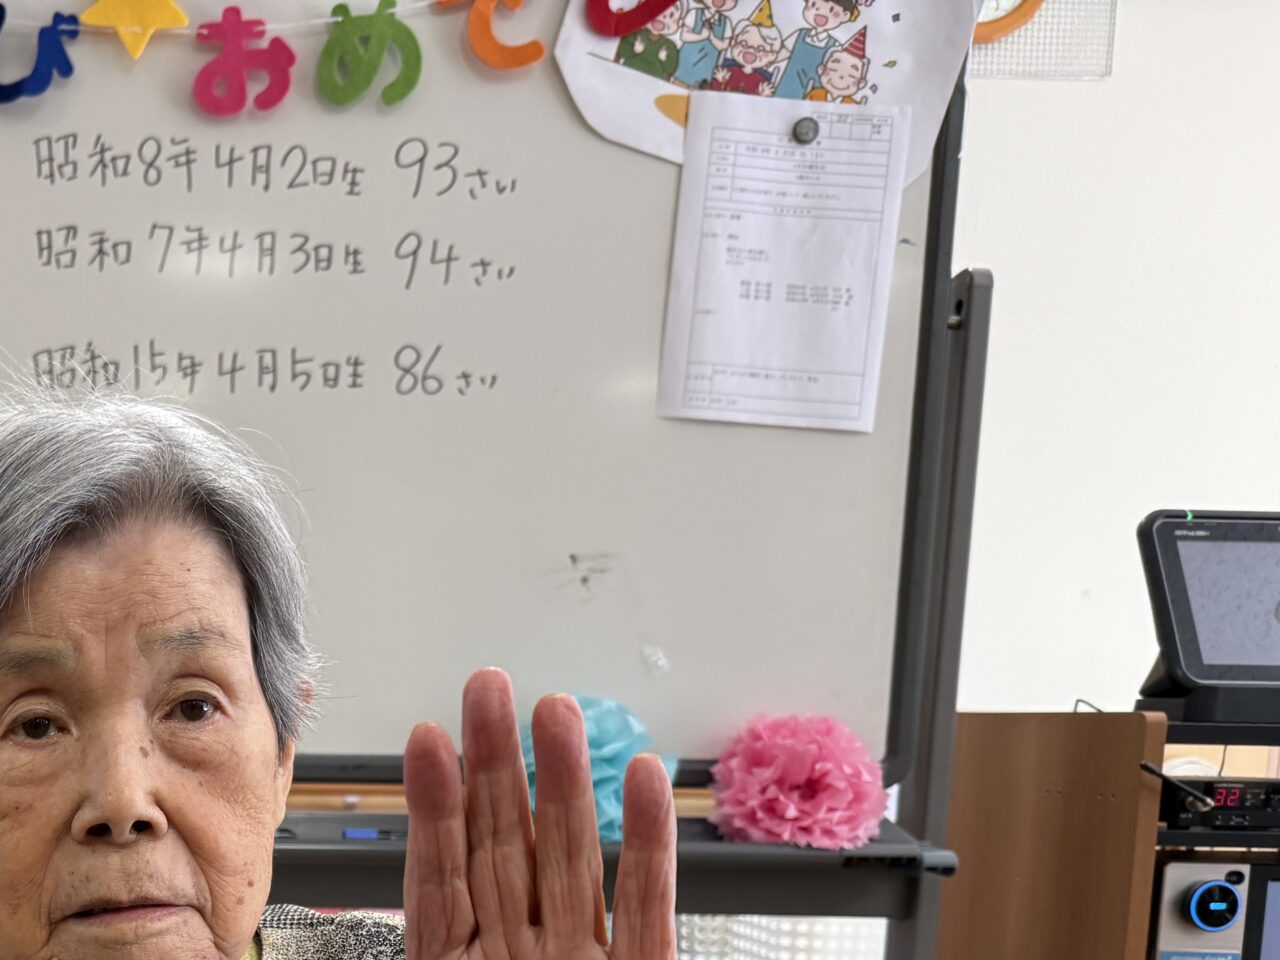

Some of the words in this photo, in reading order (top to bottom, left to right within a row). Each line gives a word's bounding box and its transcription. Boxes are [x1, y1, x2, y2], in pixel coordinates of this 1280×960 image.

[394, 138, 517, 200] 93さい
[394, 231, 516, 289] 94さい
[392, 343, 499, 396] 86さい
